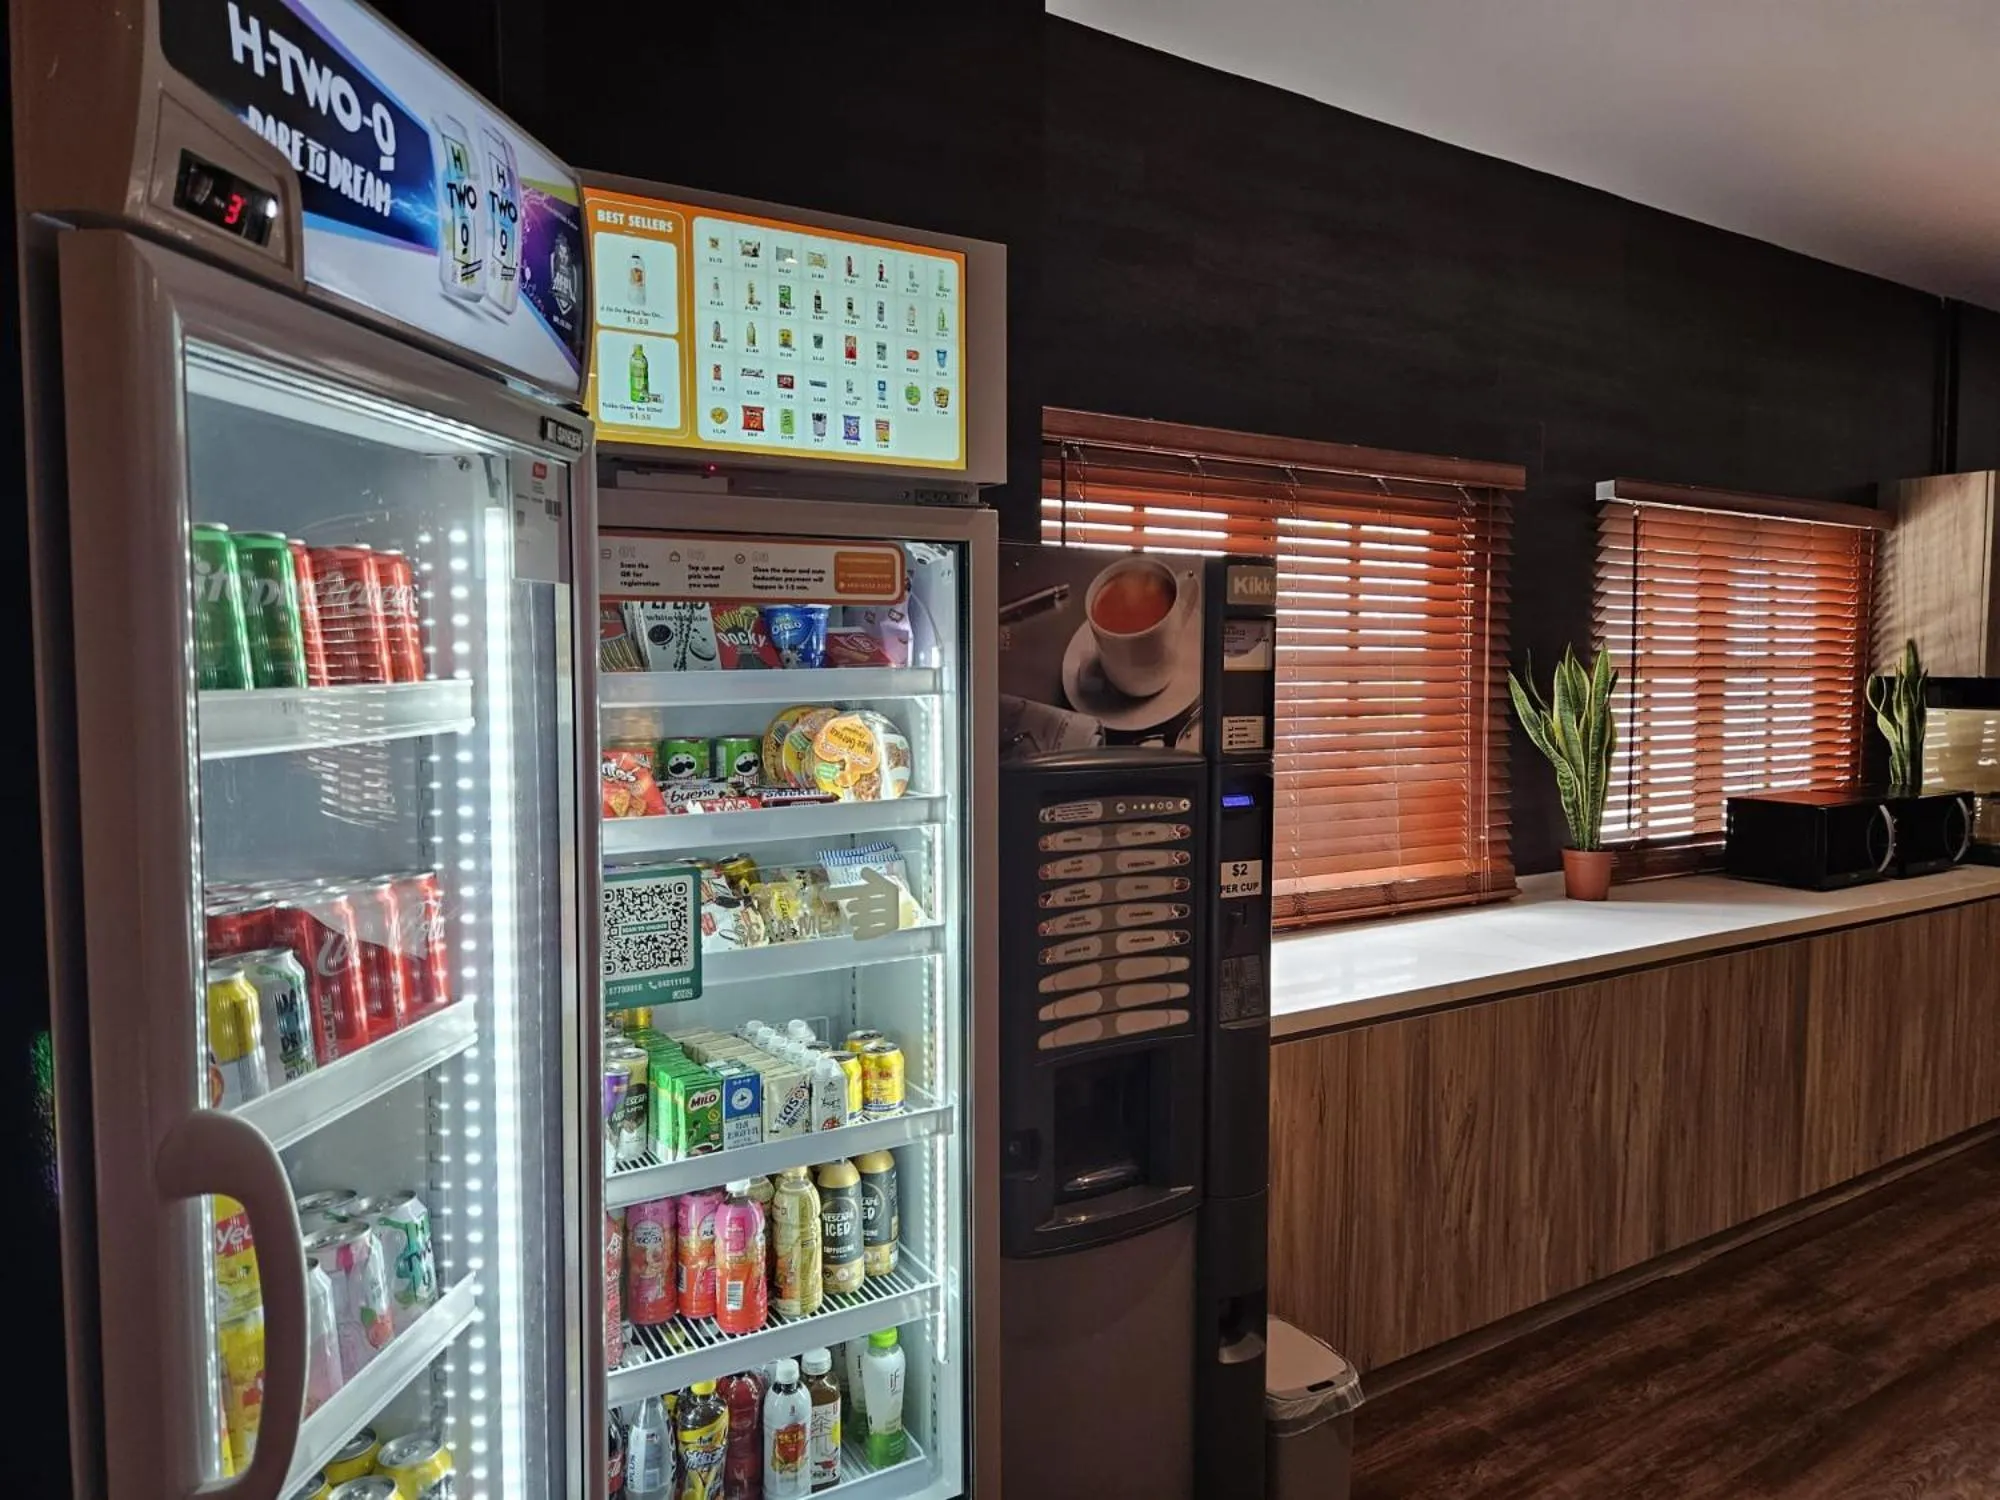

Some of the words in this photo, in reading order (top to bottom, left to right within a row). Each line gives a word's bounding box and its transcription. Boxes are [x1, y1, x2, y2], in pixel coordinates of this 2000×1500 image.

[450, 146, 462, 172] H
[305, 137, 327, 183] TO
[328, 147, 392, 217] DREAM
[497, 168, 507, 189] H
[447, 182, 477, 211] TWO
[489, 190, 519, 224] TWO
[596, 209, 625, 225] BEST
[628, 215, 674, 233] SELLERS
[712, 564, 725, 572] and
[798, 567, 811, 575] and
[1233, 575, 1273, 596] Kikk
[671, 788, 715, 803] bueno
[1232, 863, 1248, 878] $2
[1219, 883, 1239, 894] PER
[1240, 882, 1260, 893] CUP
[690, 1094, 717, 1109] MILO
[825, 1221, 851, 1237] ICED
